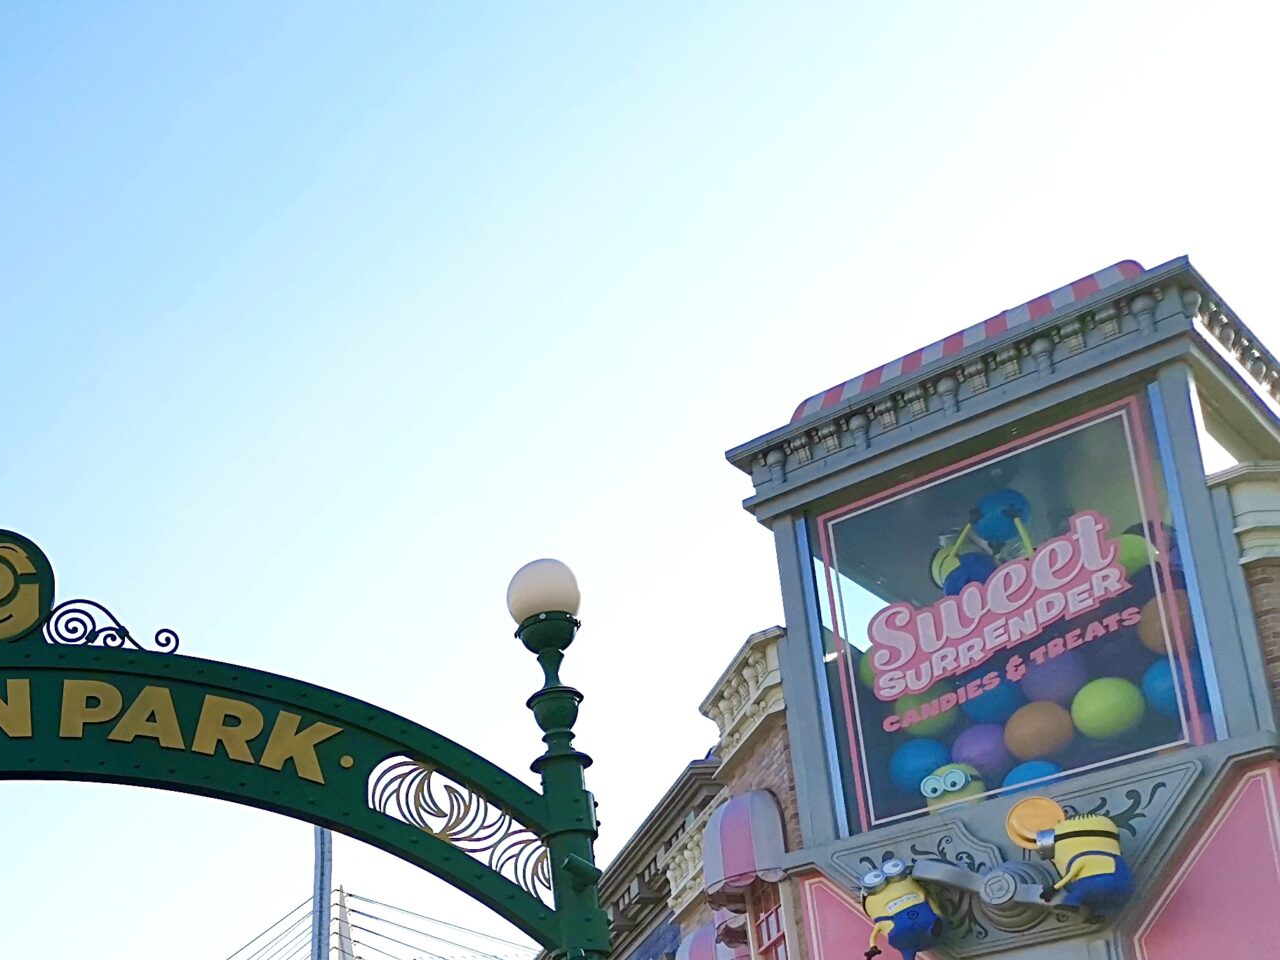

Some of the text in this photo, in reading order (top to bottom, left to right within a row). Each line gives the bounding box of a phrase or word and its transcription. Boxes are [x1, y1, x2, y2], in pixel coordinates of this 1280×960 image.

[871, 514, 1116, 671] Sweet
[877, 568, 1124, 697] SURRENDER
[60, 679, 345, 784] PARK
[882, 606, 1142, 733] CANDIES & TREATS
